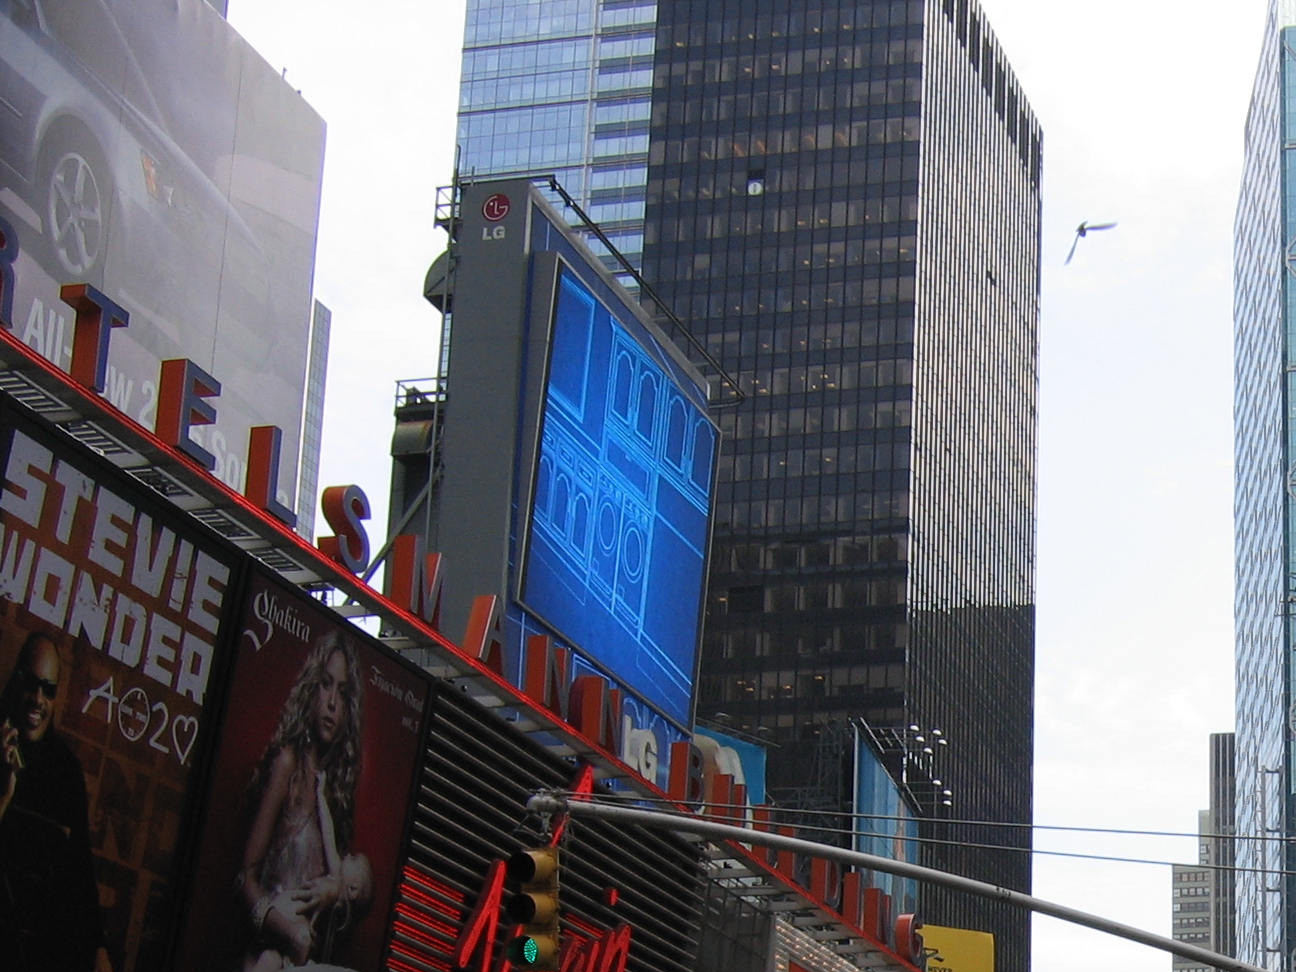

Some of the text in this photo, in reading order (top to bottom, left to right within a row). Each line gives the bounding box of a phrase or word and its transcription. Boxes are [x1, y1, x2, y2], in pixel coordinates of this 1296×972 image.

[482, 226, 506, 240] LG
[0, 429, 231, 636] STEVIE
[0, 522, 214, 706] WONDER
[243, 588, 311, 652] Shakira
